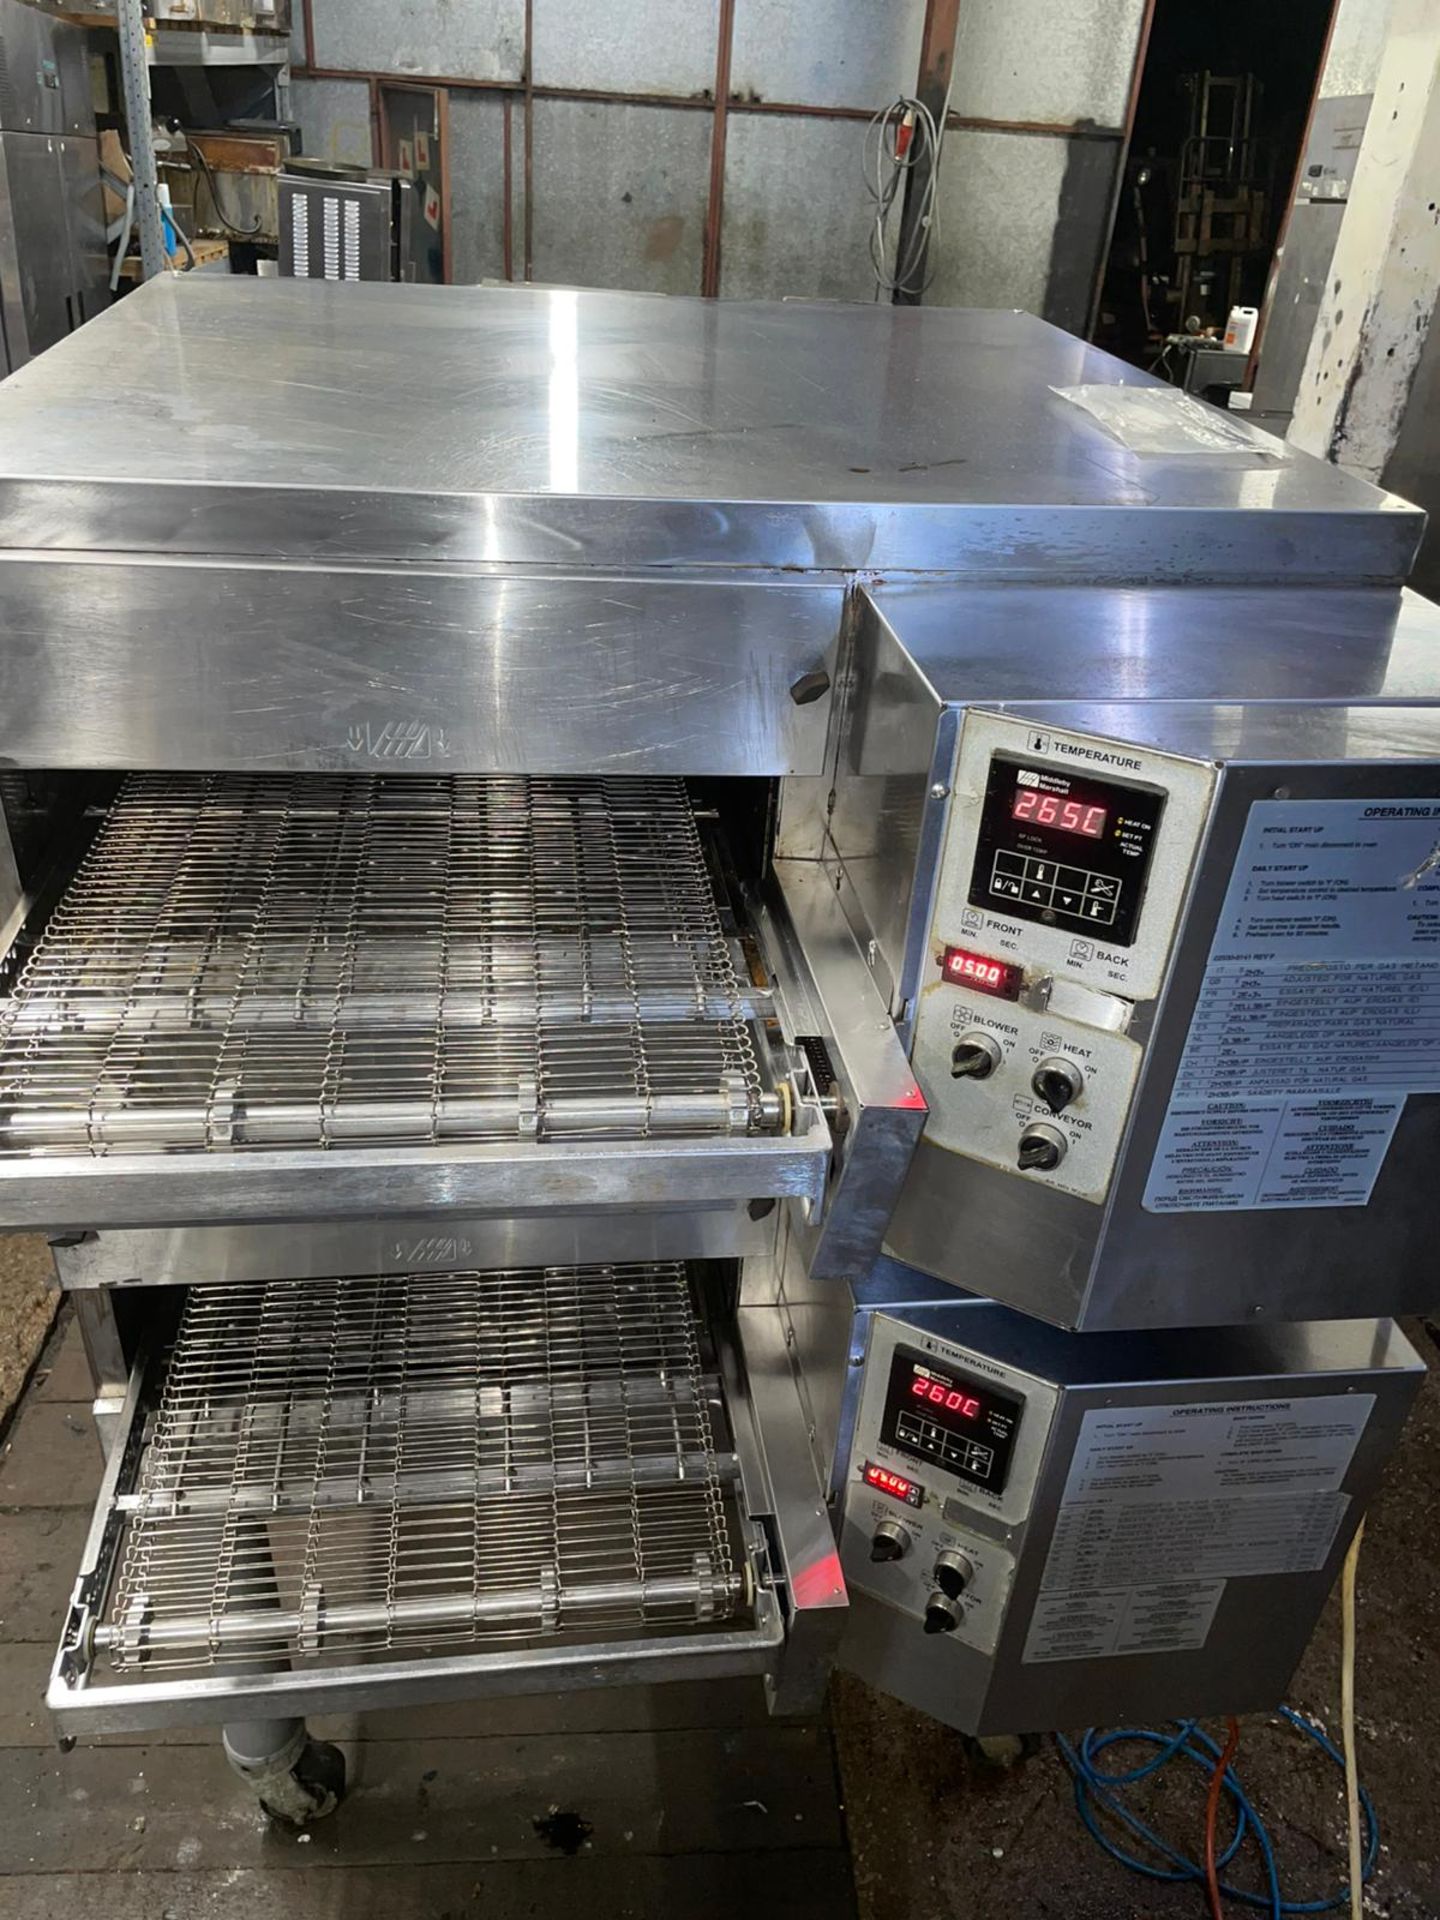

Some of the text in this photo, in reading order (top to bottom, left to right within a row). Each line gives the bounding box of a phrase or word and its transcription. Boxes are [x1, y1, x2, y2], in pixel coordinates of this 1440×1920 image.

[1053, 741, 1143, 771] TEMPERATURE
[1014, 791, 1105, 834] 265C
[1363, 806, 1431, 818] OPERATING
[960, 927, 978, 939] MIN.
[985, 918, 1024, 938] FRONT
[999, 938, 1019, 951] SEC.
[1066, 958, 1085, 970] MIN.
[1095, 950, 1130, 968] BACK
[1107, 969, 1128, 982] SEC.
[949, 1021, 967, 1033] OFF
[972, 1014, 1020, 1037] BLOWER
[1002, 1037, 1017, 1049] ON
[1028, 1046, 1046, 1058] OFF
[1063, 1042, 1093, 1060] HEAT
[1084, 1064, 1098, 1076] ON
[1015, 1111, 1031, 1122] OFF
[1033, 1104, 1094, 1132] CONVEYOR
[1068, 1130, 1082, 1140] ON
[939, 1346, 1007, 1379] TEMPERATURE
[911, 1377, 980, 1418] 260C
